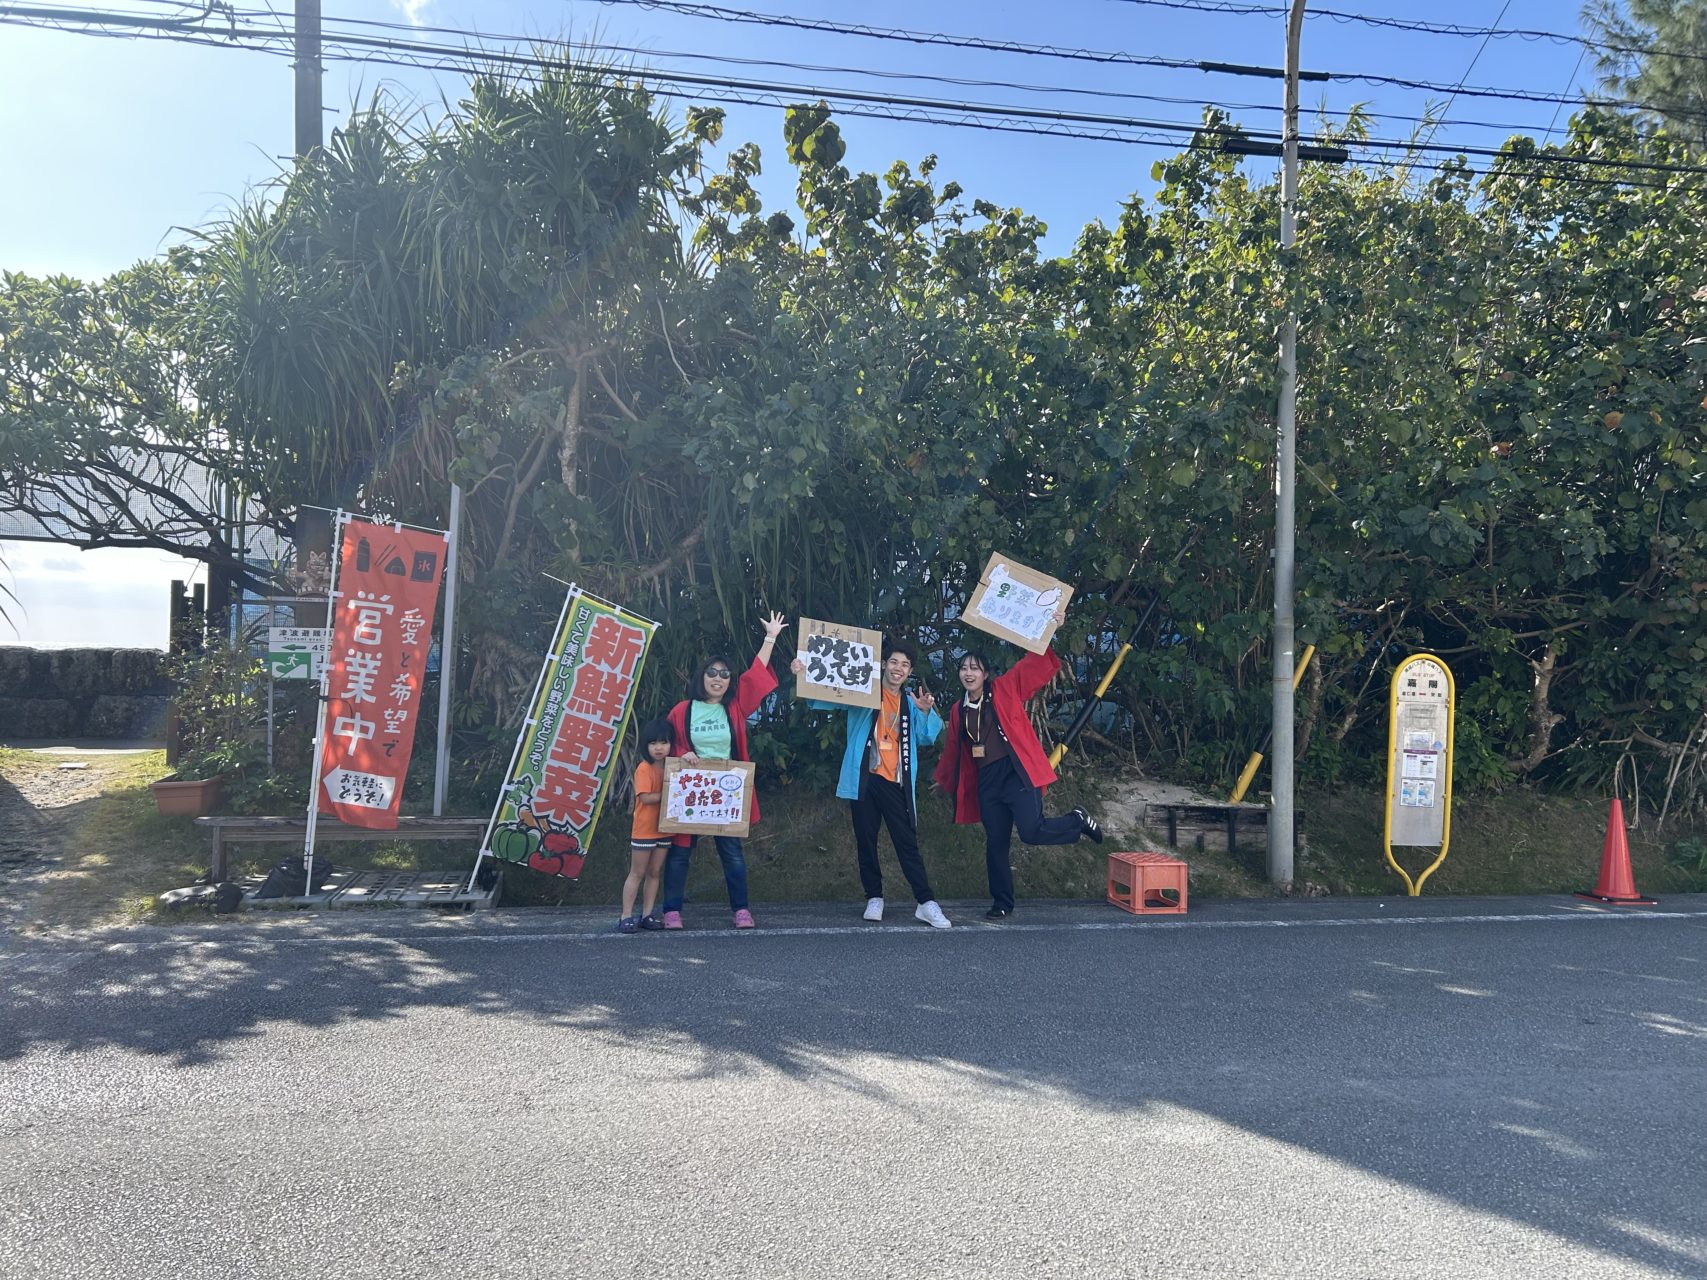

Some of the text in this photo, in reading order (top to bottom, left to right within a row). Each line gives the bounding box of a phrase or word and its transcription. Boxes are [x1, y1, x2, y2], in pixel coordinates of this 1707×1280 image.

[997, 582, 1035, 608] 野菜
[808, 635, 869, 663] やさい
[332, 590, 394, 757] 営業中
[382, 607, 426, 758] 愛と希望で
[808, 657, 874, 686] うってます
[529, 606, 592, 772] 甘くて美味しい野菜をどうぞ。
[532, 613, 645, 829] 新鮮野菜
[340, 773, 383, 789] お気軽に
[679, 773, 716, 790] やさい
[339, 786, 384, 806] どうぞ!
